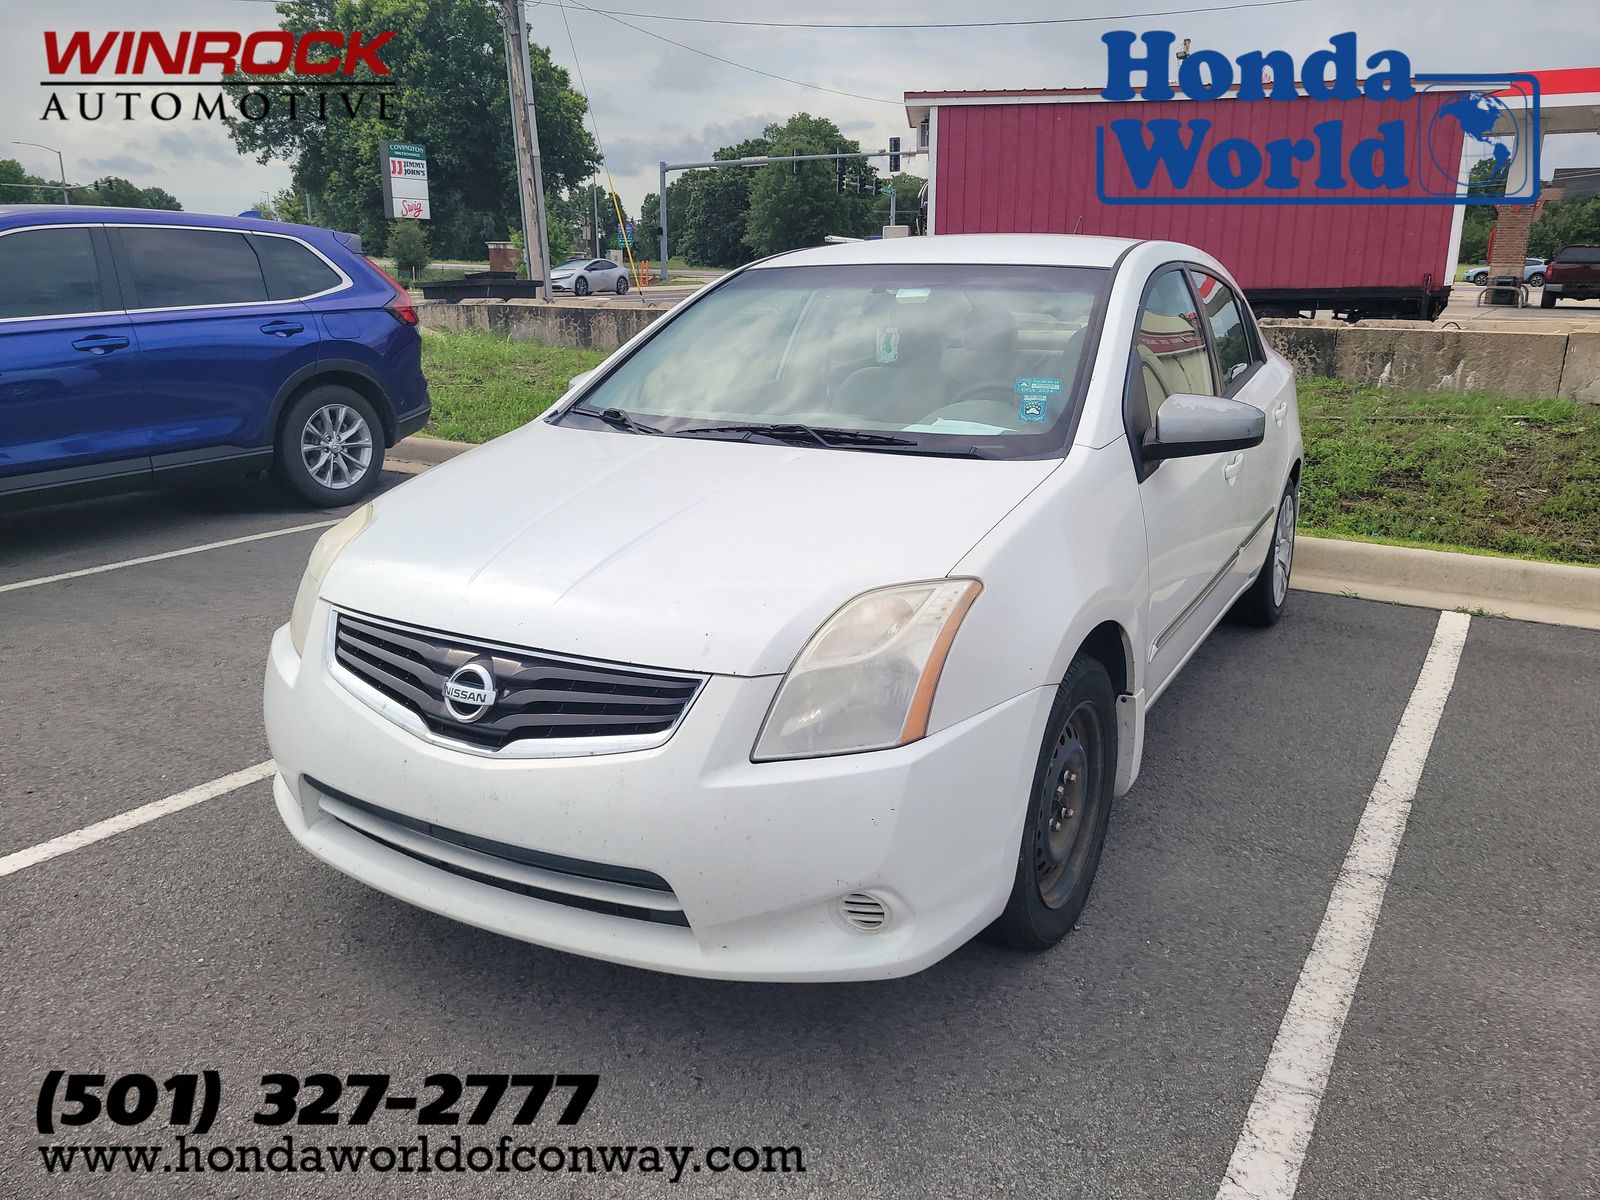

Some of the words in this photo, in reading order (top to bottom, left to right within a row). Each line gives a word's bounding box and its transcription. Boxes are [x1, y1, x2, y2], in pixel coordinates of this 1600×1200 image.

[389, 144, 424, 153] COVINGTON
[403, 161, 425, 169] JIMMY
[404, 168, 426, 176] JOHN'S
[401, 200, 423, 218] Swig
[444, 683, 486, 702] NISSAN
